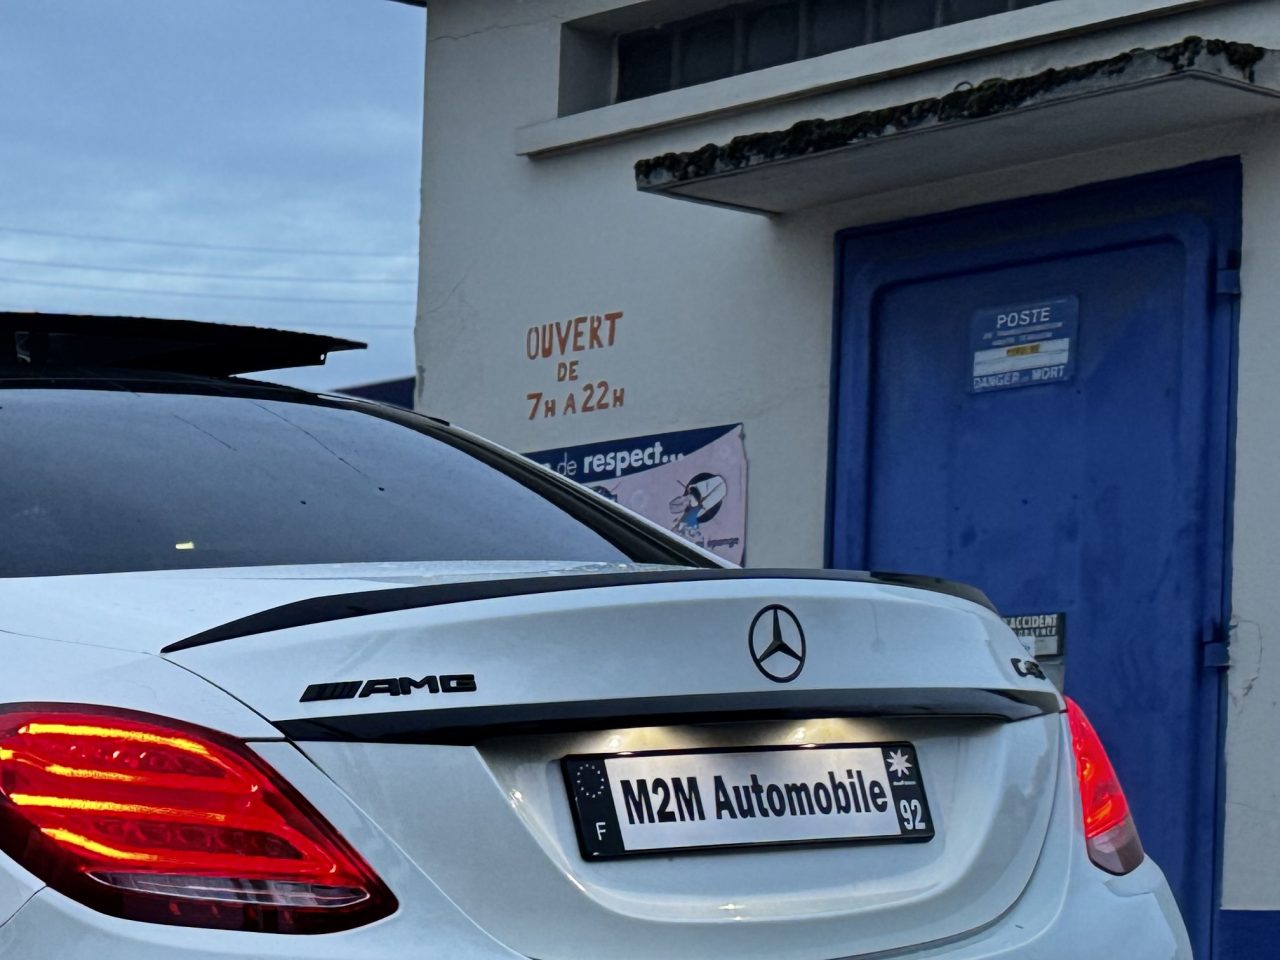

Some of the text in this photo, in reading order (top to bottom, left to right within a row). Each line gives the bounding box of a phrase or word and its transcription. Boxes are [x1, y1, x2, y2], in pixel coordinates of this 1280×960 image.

[996, 307, 1051, 328] POSTE
[526, 311, 624, 360] OUVERT
[557, 360, 579, 382] DE
[526, 381, 625, 420] 7H A 22H
[557, 450, 577, 475] de
[358, 674, 477, 698] AMG
[595, 768, 927, 841] F M2M Automobile 92
